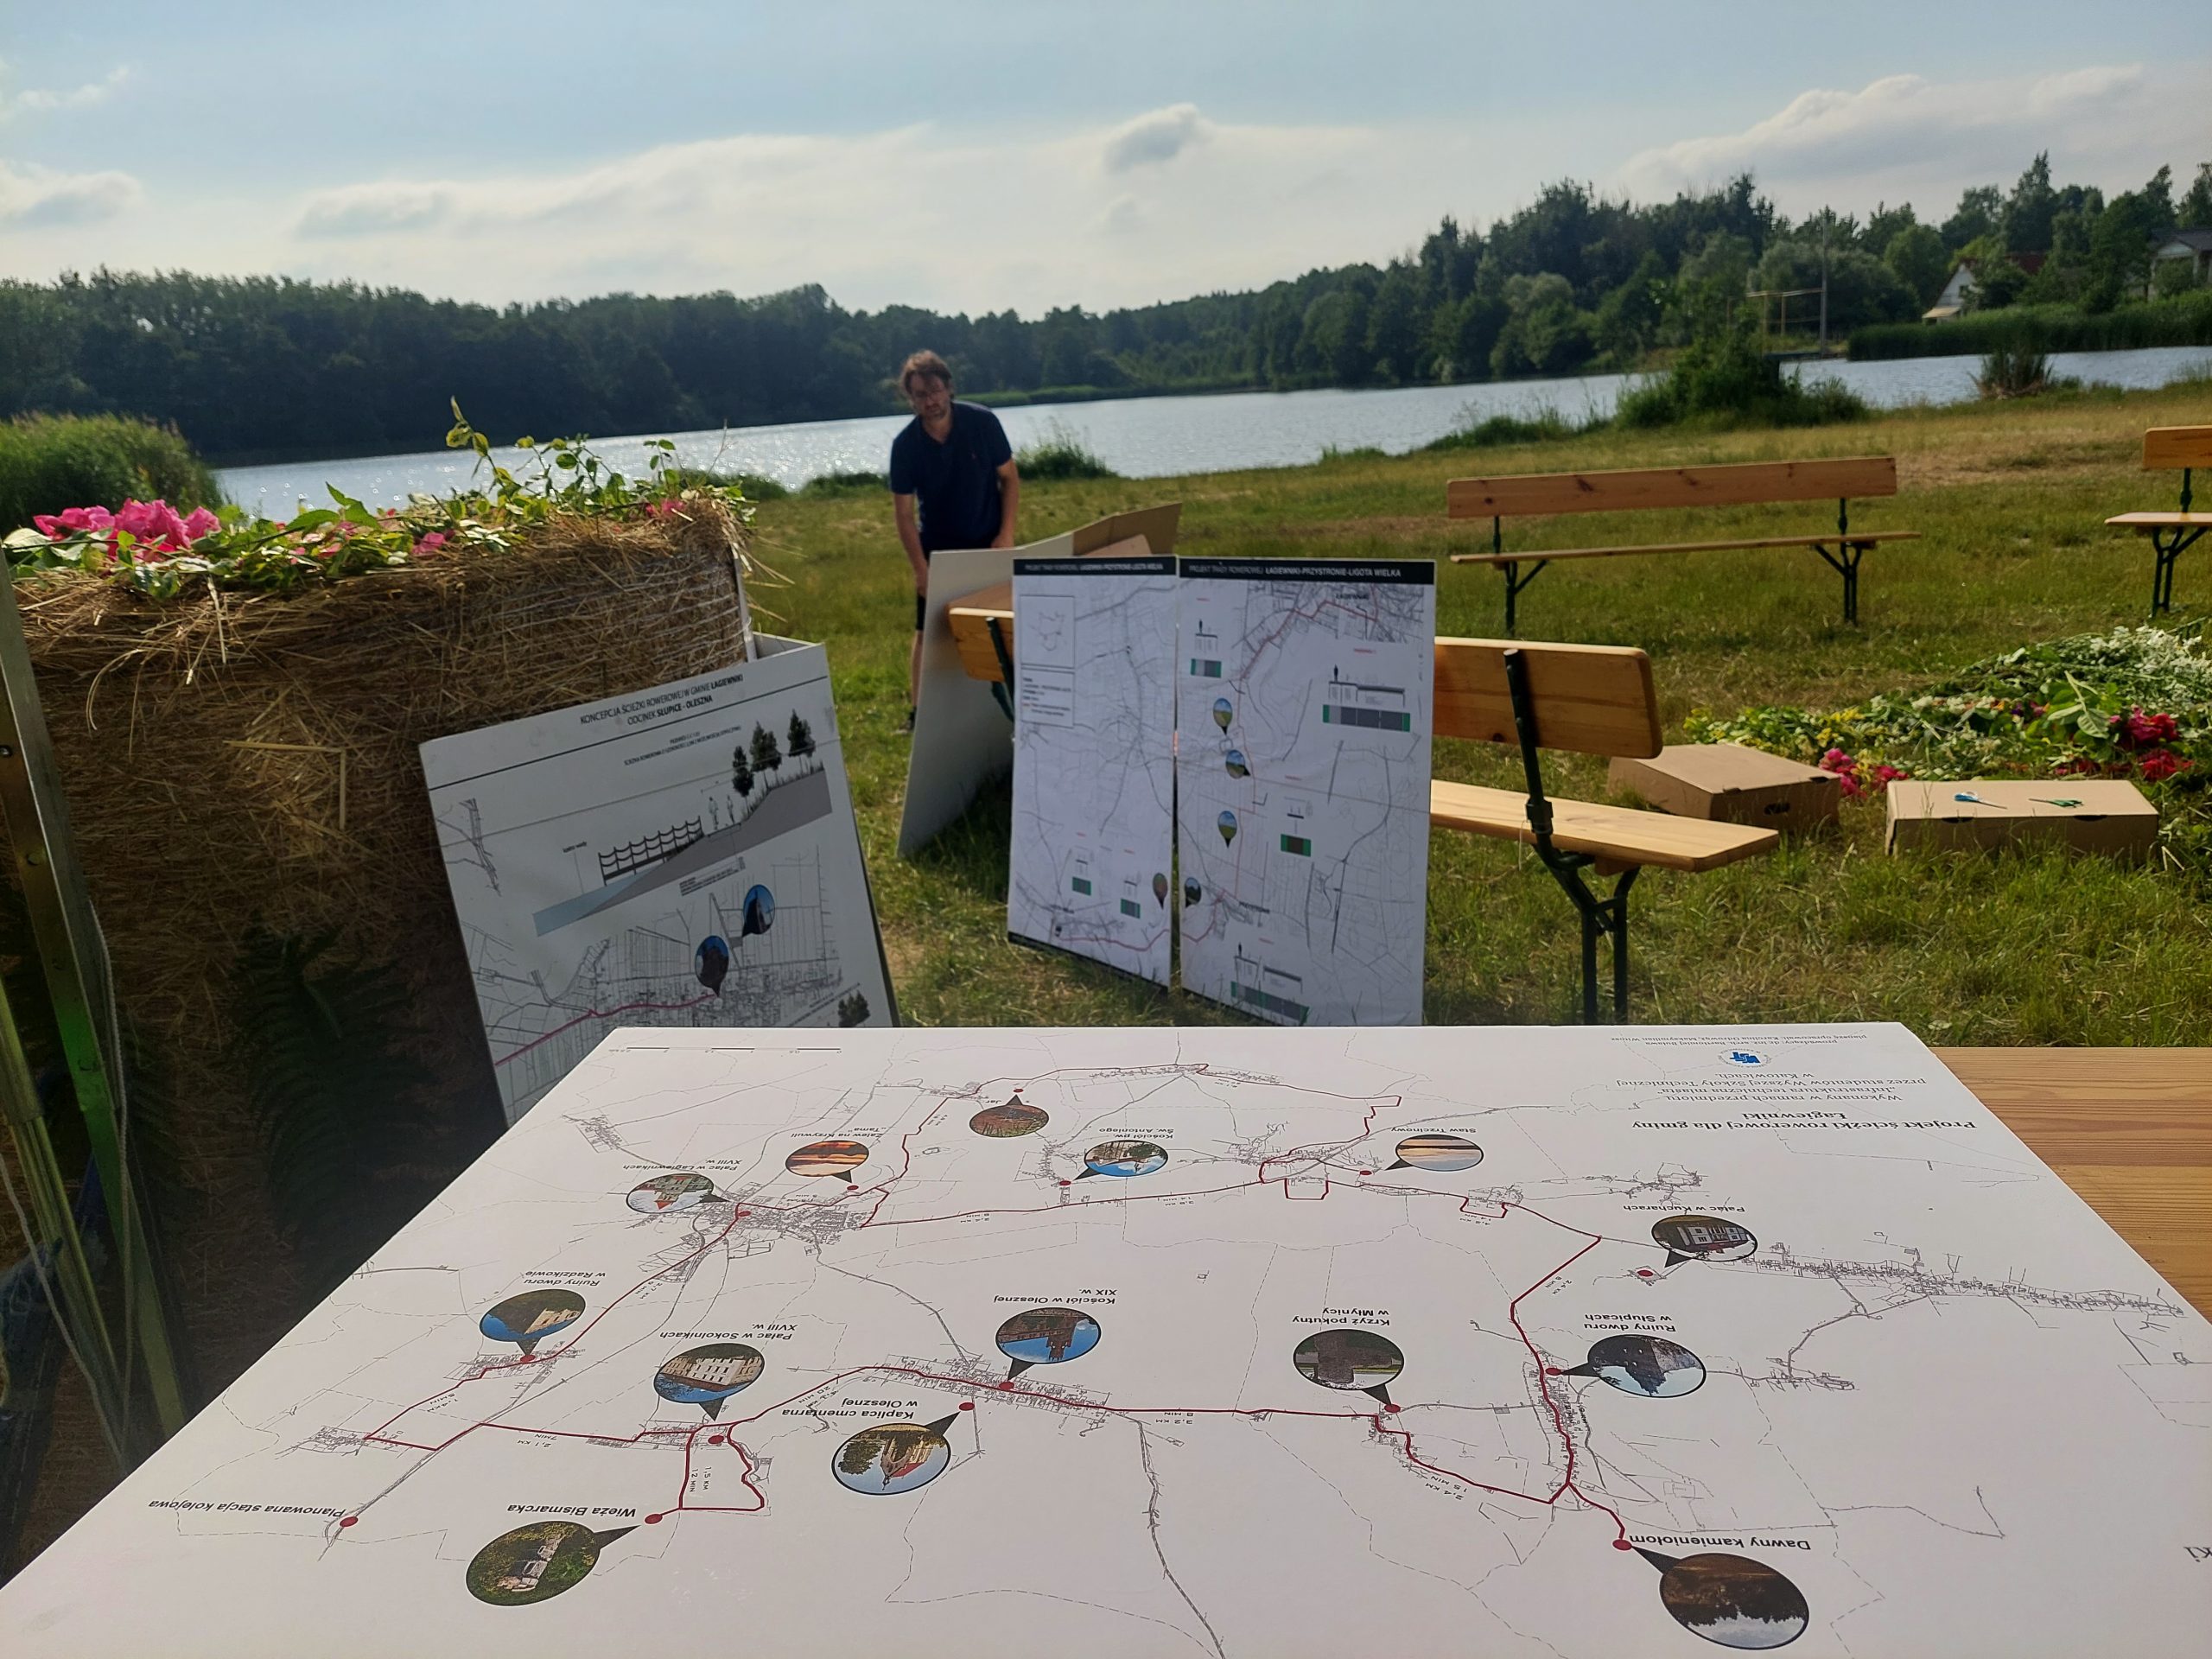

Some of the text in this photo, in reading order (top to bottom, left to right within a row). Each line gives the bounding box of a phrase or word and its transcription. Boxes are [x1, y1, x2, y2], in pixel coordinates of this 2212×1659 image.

[1374, 568, 1402, 578] WIELKA
[580, 707, 621, 725] KONCEPCJA
[622, 699, 646, 715] ŚCIEŻKI
[646, 691, 684, 709] ROWEROWEJ
[690, 684, 711, 696] GMINIE
[710, 673, 744, 690] ŁAGIEWNIKI
[627, 712, 657, 726] ODCINEK
[656, 704, 682, 717] SŁUPICE
[686, 695, 713, 709] OLESZNA
[1742, 1111, 1848, 1121] Łagiewniki
[1632, 1121, 1689, 1130] gminy
[1726, 1121, 1828, 1130] rowerowej
[1901, 1120, 1977, 1129] Projekt
[993, 1295, 1049, 1304] Olesznej
[1322, 1307, 1374, 1317] Młynicy
[1292, 1315, 1390, 1326] Krzyż pokutny
[1584, 1313, 1656, 1323] Słupicach
[1583, 1323, 1677, 1332] Ruiny dworu
[659, 1332, 739, 1340] Sokolnikach
[841, 1398, 903, 1408] Olesznej
[781, 1408, 914, 1419] Kaplica cmentarna
[691, 1468, 699, 1478] 12
[1430, 1476, 1450, 1485] MIN
[702, 1481, 709, 1491] KM
[1424, 1483, 1440, 1491] KM
[148, 1500, 346, 1517] Planowana stacja kolejowa
[506, 1504, 638, 1518] Wieża Bismarcka
[1629, 1535, 1812, 1551] Dawny kamieniołom
